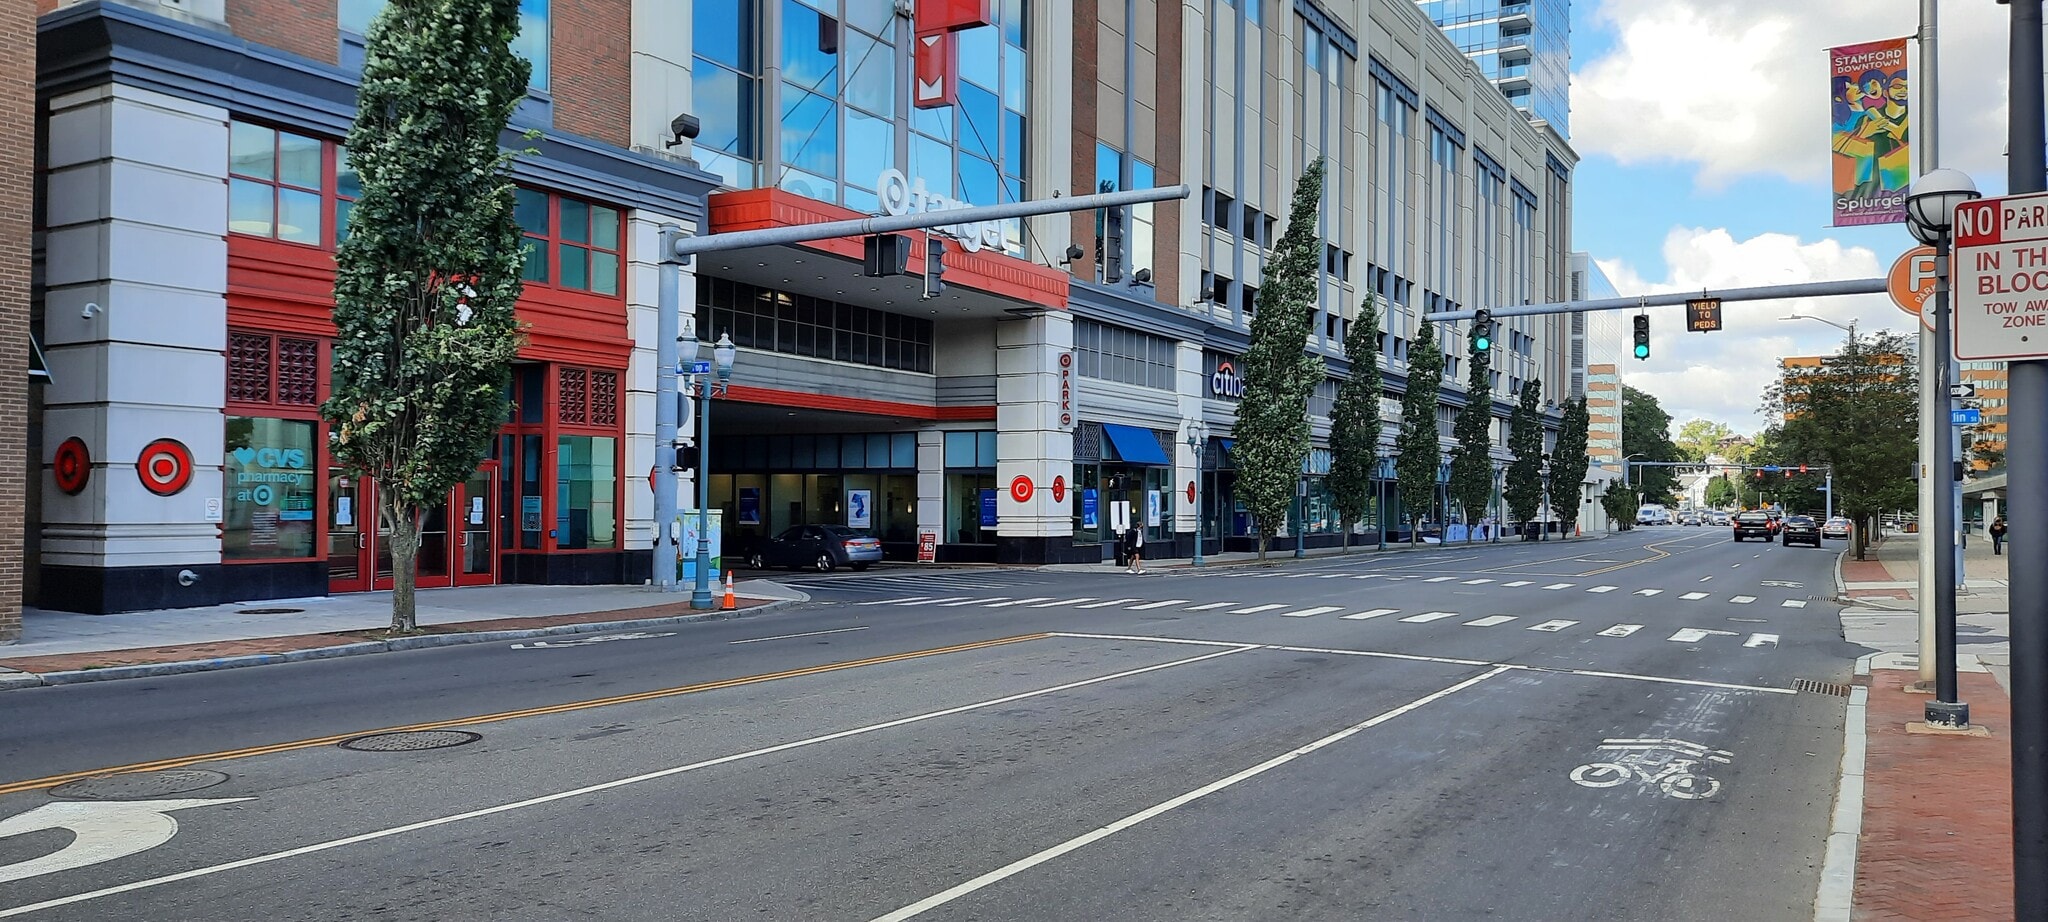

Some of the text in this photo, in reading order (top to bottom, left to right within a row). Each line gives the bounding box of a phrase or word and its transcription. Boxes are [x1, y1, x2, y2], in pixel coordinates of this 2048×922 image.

[1834, 49, 1902, 67] STAMFORD
[1837, 58, 1900, 74] DOWNTOWN
[1836, 193, 1906, 212] Splurge!
[1957, 204, 2048, 238] NO PAR
[1976, 251, 2000, 272] IN
[1909, 255, 1937, 293] P
[1692, 301, 1717, 311] YIELD
[1984, 299, 2048, 316] TOW AW
[1698, 311, 1711, 319] TO
[2002, 314, 2046, 329] ZONE
[1693, 320, 1716, 330] PEDS
[1062, 370, 1070, 411] PARK
[257, 447, 304, 469] CVS
[237, 472, 303, 486] pharmacy
[237, 488, 252, 502] at
